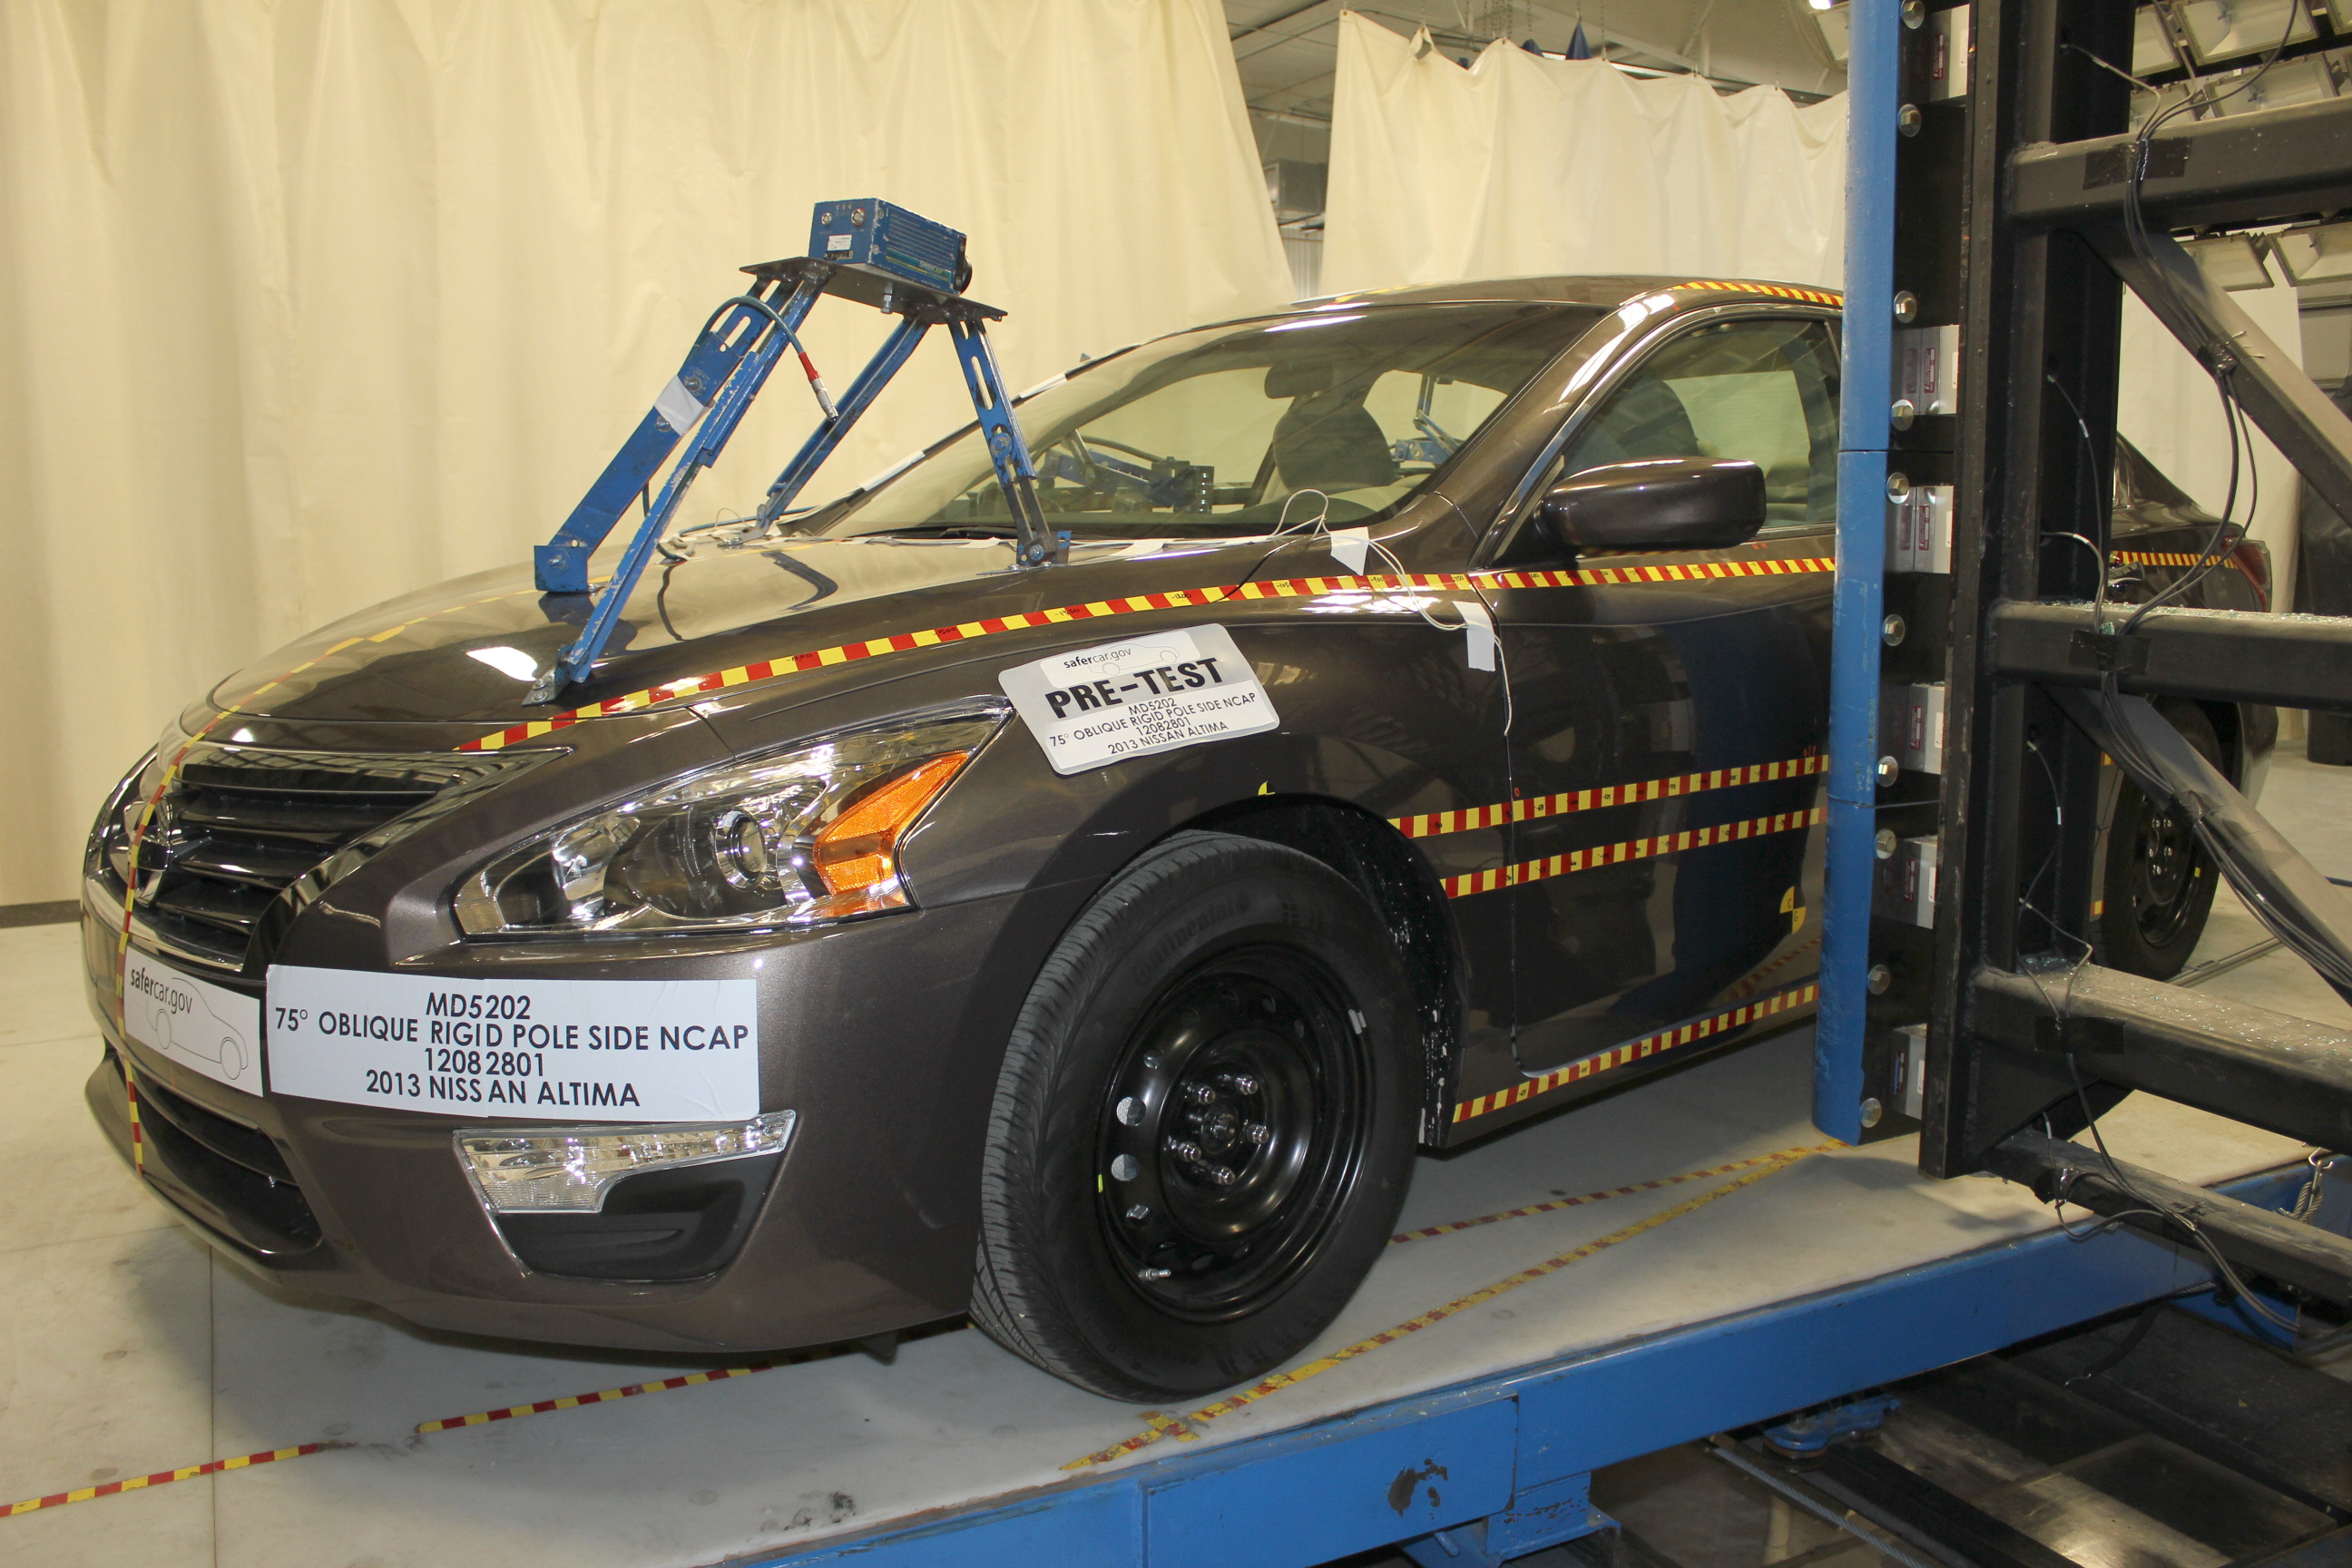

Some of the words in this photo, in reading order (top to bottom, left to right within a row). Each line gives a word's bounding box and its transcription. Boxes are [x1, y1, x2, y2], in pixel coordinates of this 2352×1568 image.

[1063, 648, 1132, 669] safercar.gov
[1044, 658, 1223, 719] PRE-TEST
[1049, 733, 1069, 747] 75°
[1074, 720, 1128, 740] OBLIQUE
[1132, 711, 1164, 727] RIGID
[1167, 704, 1193, 720] POLE
[1199, 700, 1221, 712] SIDE
[1224, 692, 1256, 708] NCAP
[1128, 698, 1177, 715] MD5202
[1107, 740, 1139, 754] 2013
[1142, 730, 1185, 748] NISSAN
[1188, 721, 1229, 738] ALTIMA
[1136, 717, 1191, 736] 12082801
[130, 967, 192, 1014] safercar.gov
[426, 992, 531, 1020] MD5202
[275, 1007, 309, 1032] 75°
[318, 1011, 418, 1043] OBLIQUE
[431, 1022, 503, 1047] RIGID
[514, 1024, 578, 1050] POLE
[589, 1025, 649, 1050] SIDE
[661, 1025, 749, 1051] NCAP
[425, 1048, 543, 1076] 12082801
[366, 1069, 421, 1097] 2013
[429, 1075, 526, 1104] NISSAN
[537, 1082, 641, 1107] ALTIMA
